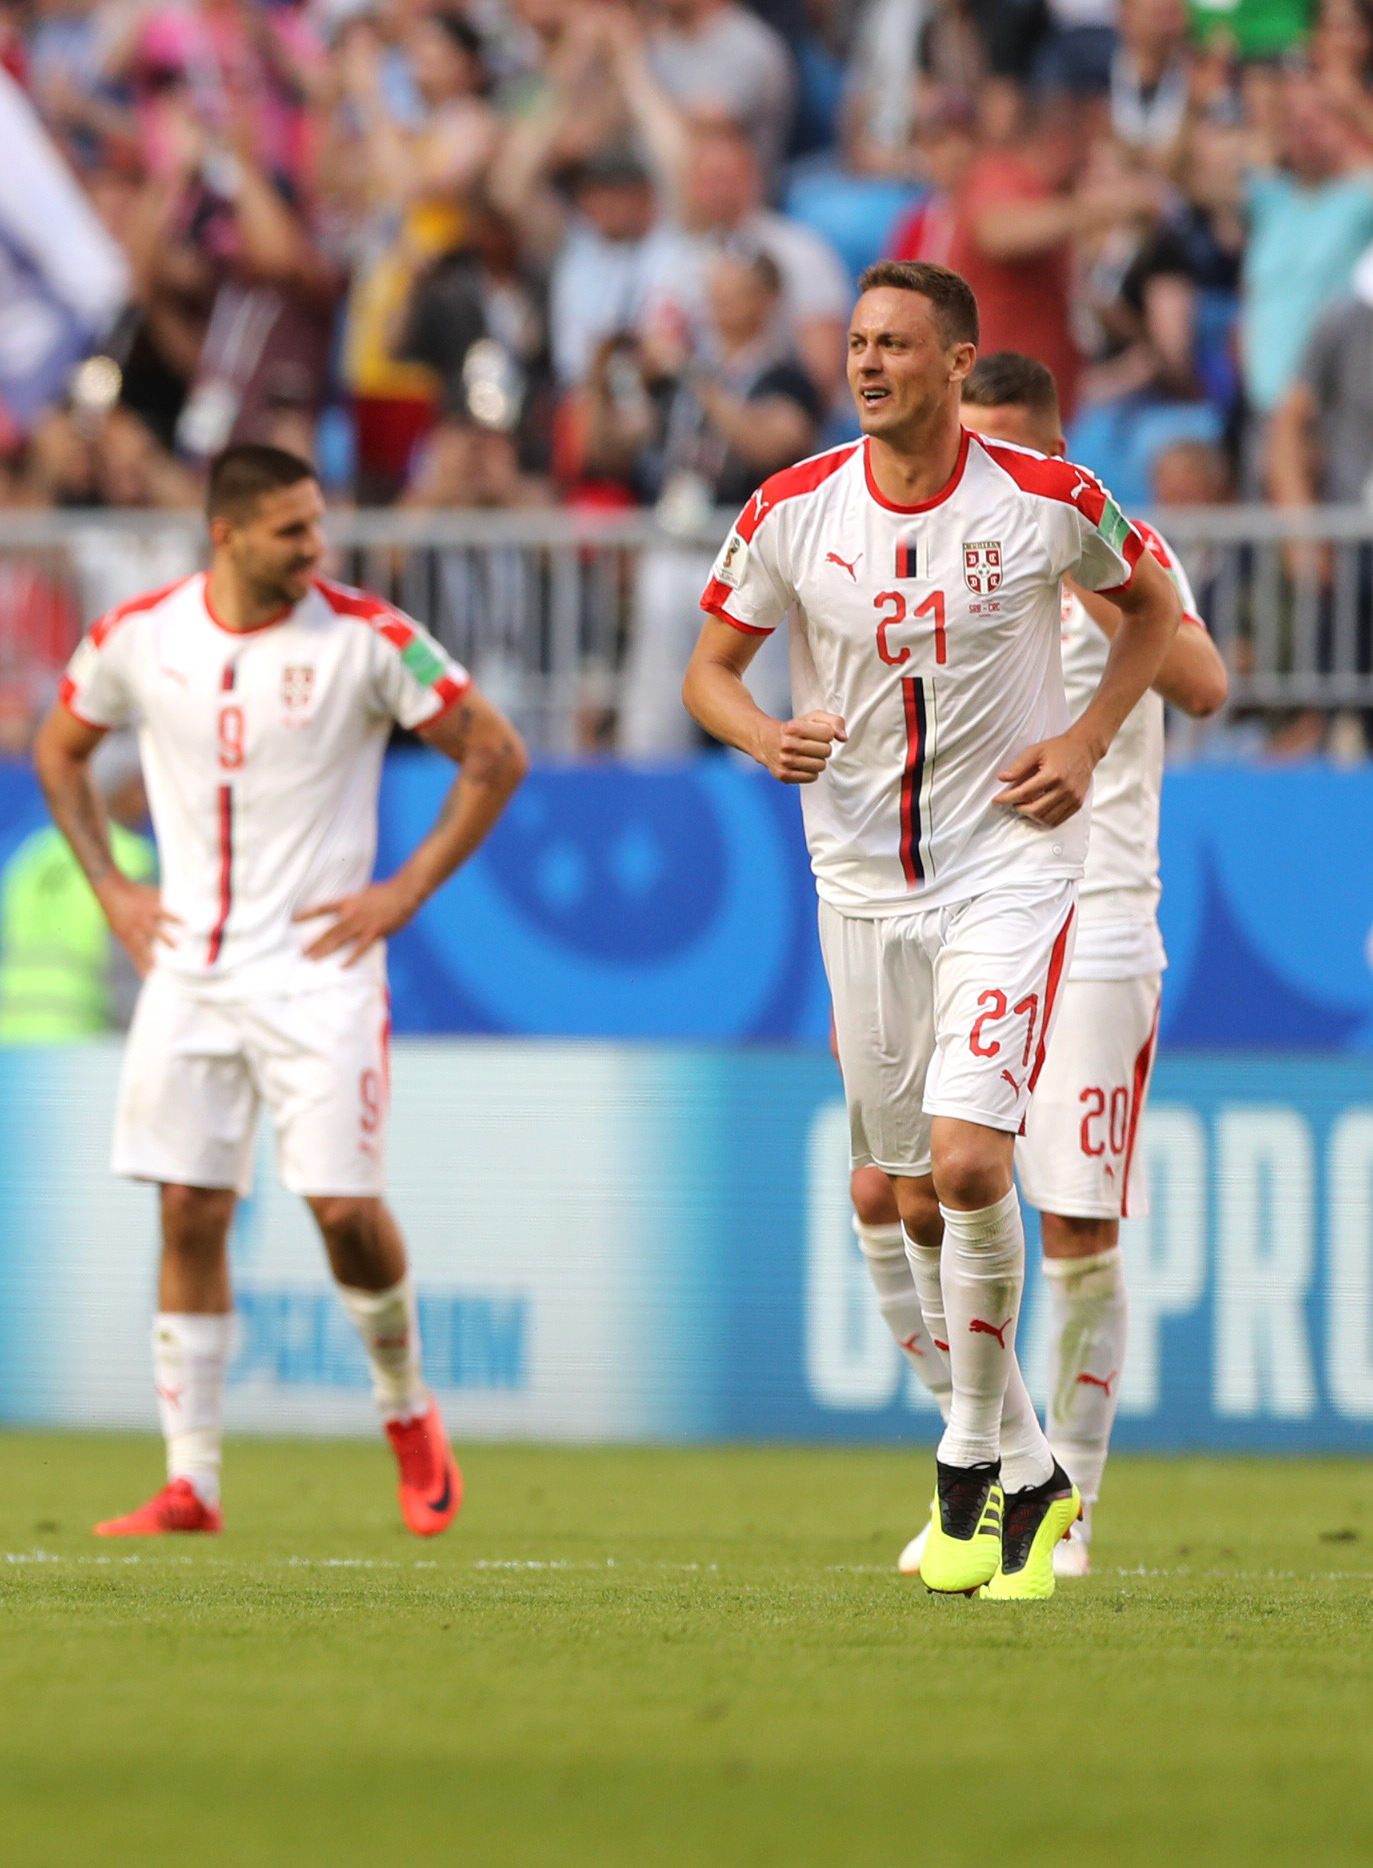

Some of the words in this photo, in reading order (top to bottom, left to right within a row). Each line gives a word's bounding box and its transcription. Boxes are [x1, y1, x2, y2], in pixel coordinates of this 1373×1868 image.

[873, 590, 947, 666] 21
[217, 705, 245, 771] 9
[969, 987, 1038, 1067] 21
[1079, 1087, 1128, 1156] 20
